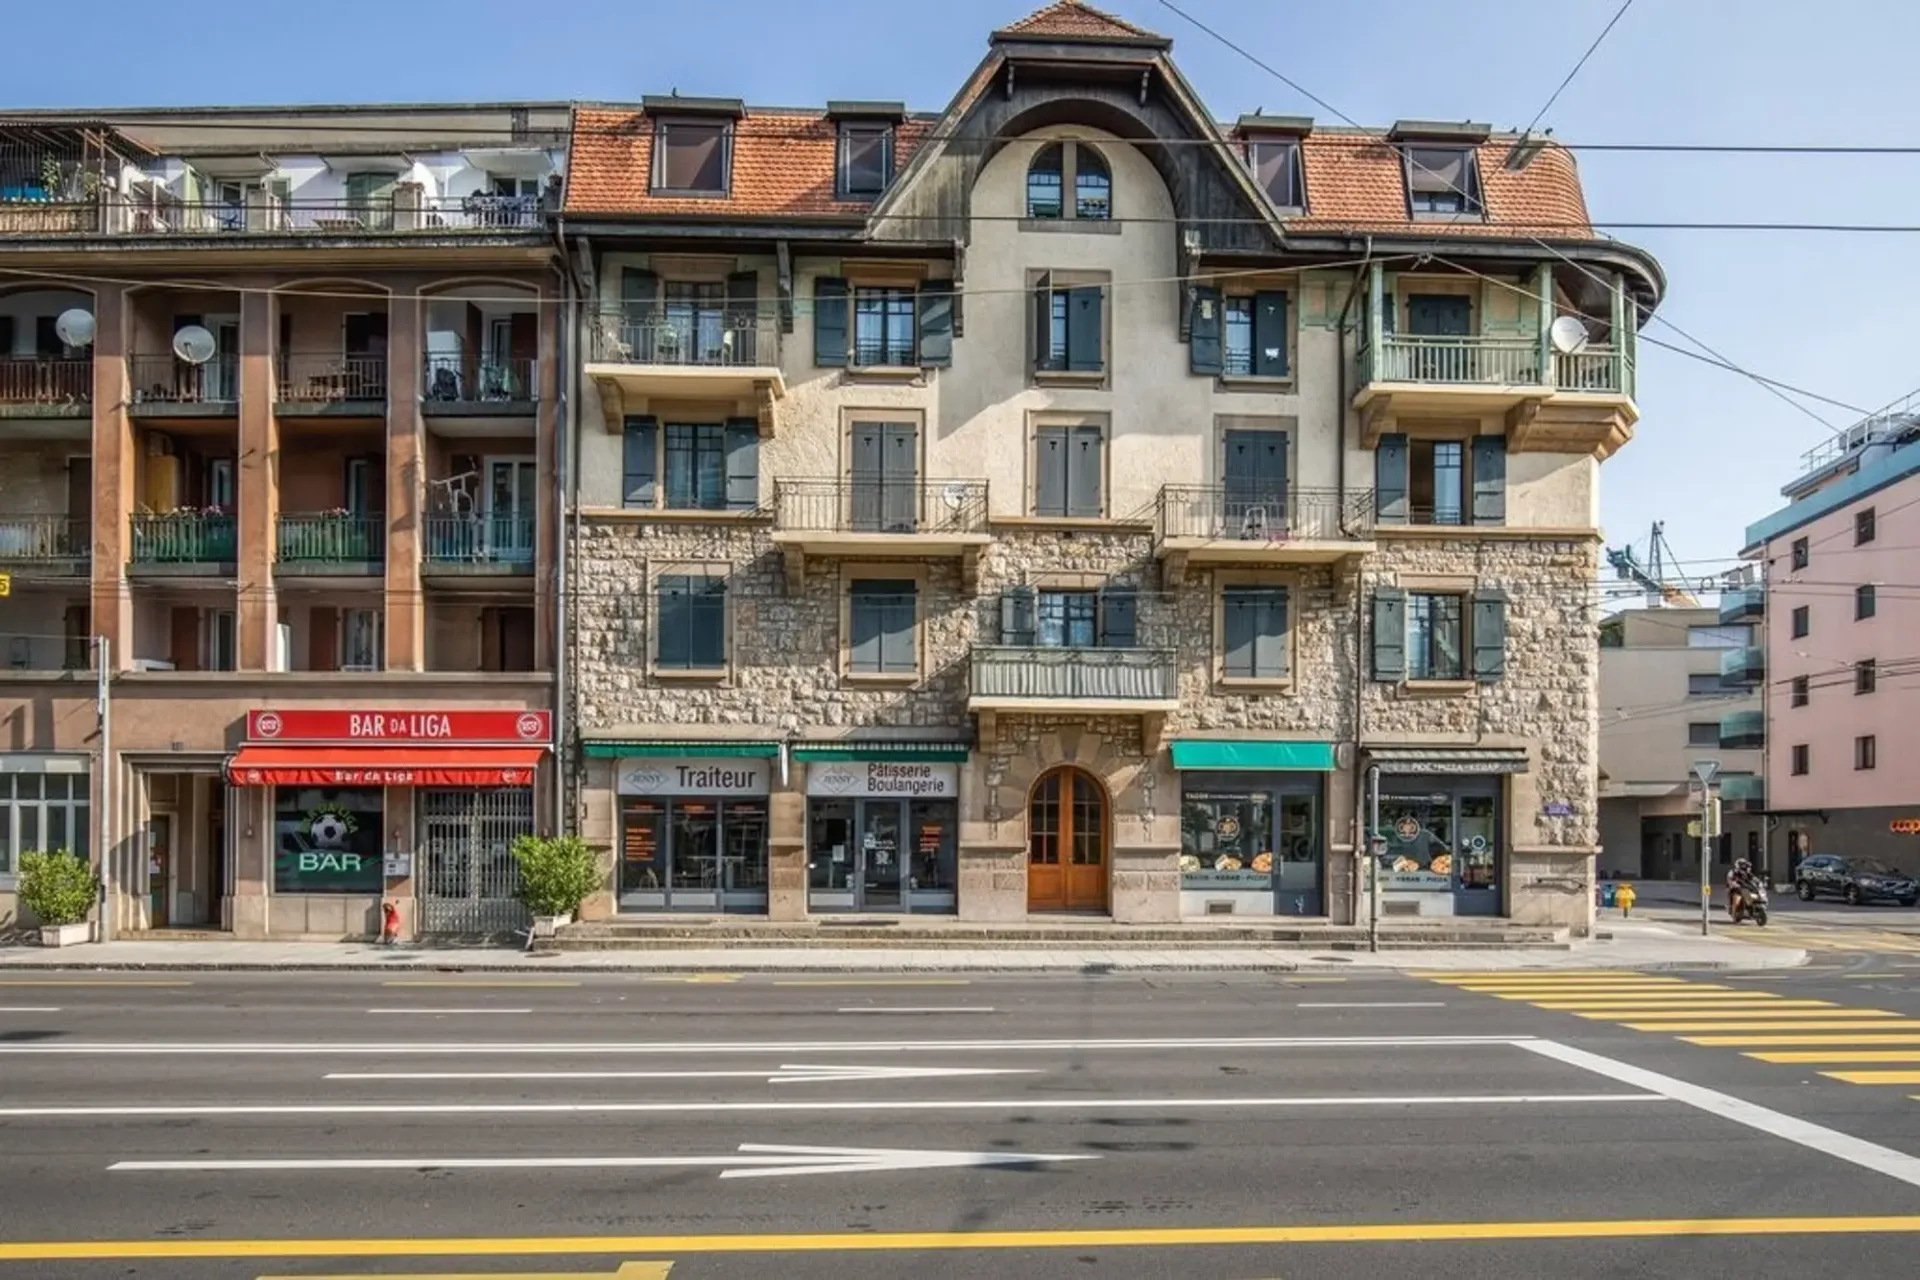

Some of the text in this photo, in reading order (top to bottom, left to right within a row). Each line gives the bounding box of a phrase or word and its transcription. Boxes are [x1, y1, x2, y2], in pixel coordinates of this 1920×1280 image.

[350, 714, 451, 737] BAR DA LIGA
[335, 770, 359, 782] Bar
[675, 765, 757, 788] Traiteur
[867, 761, 931, 777] Pâtisserie
[867, 777, 945, 795] Boulangerie
[300, 852, 361, 872] BAR
